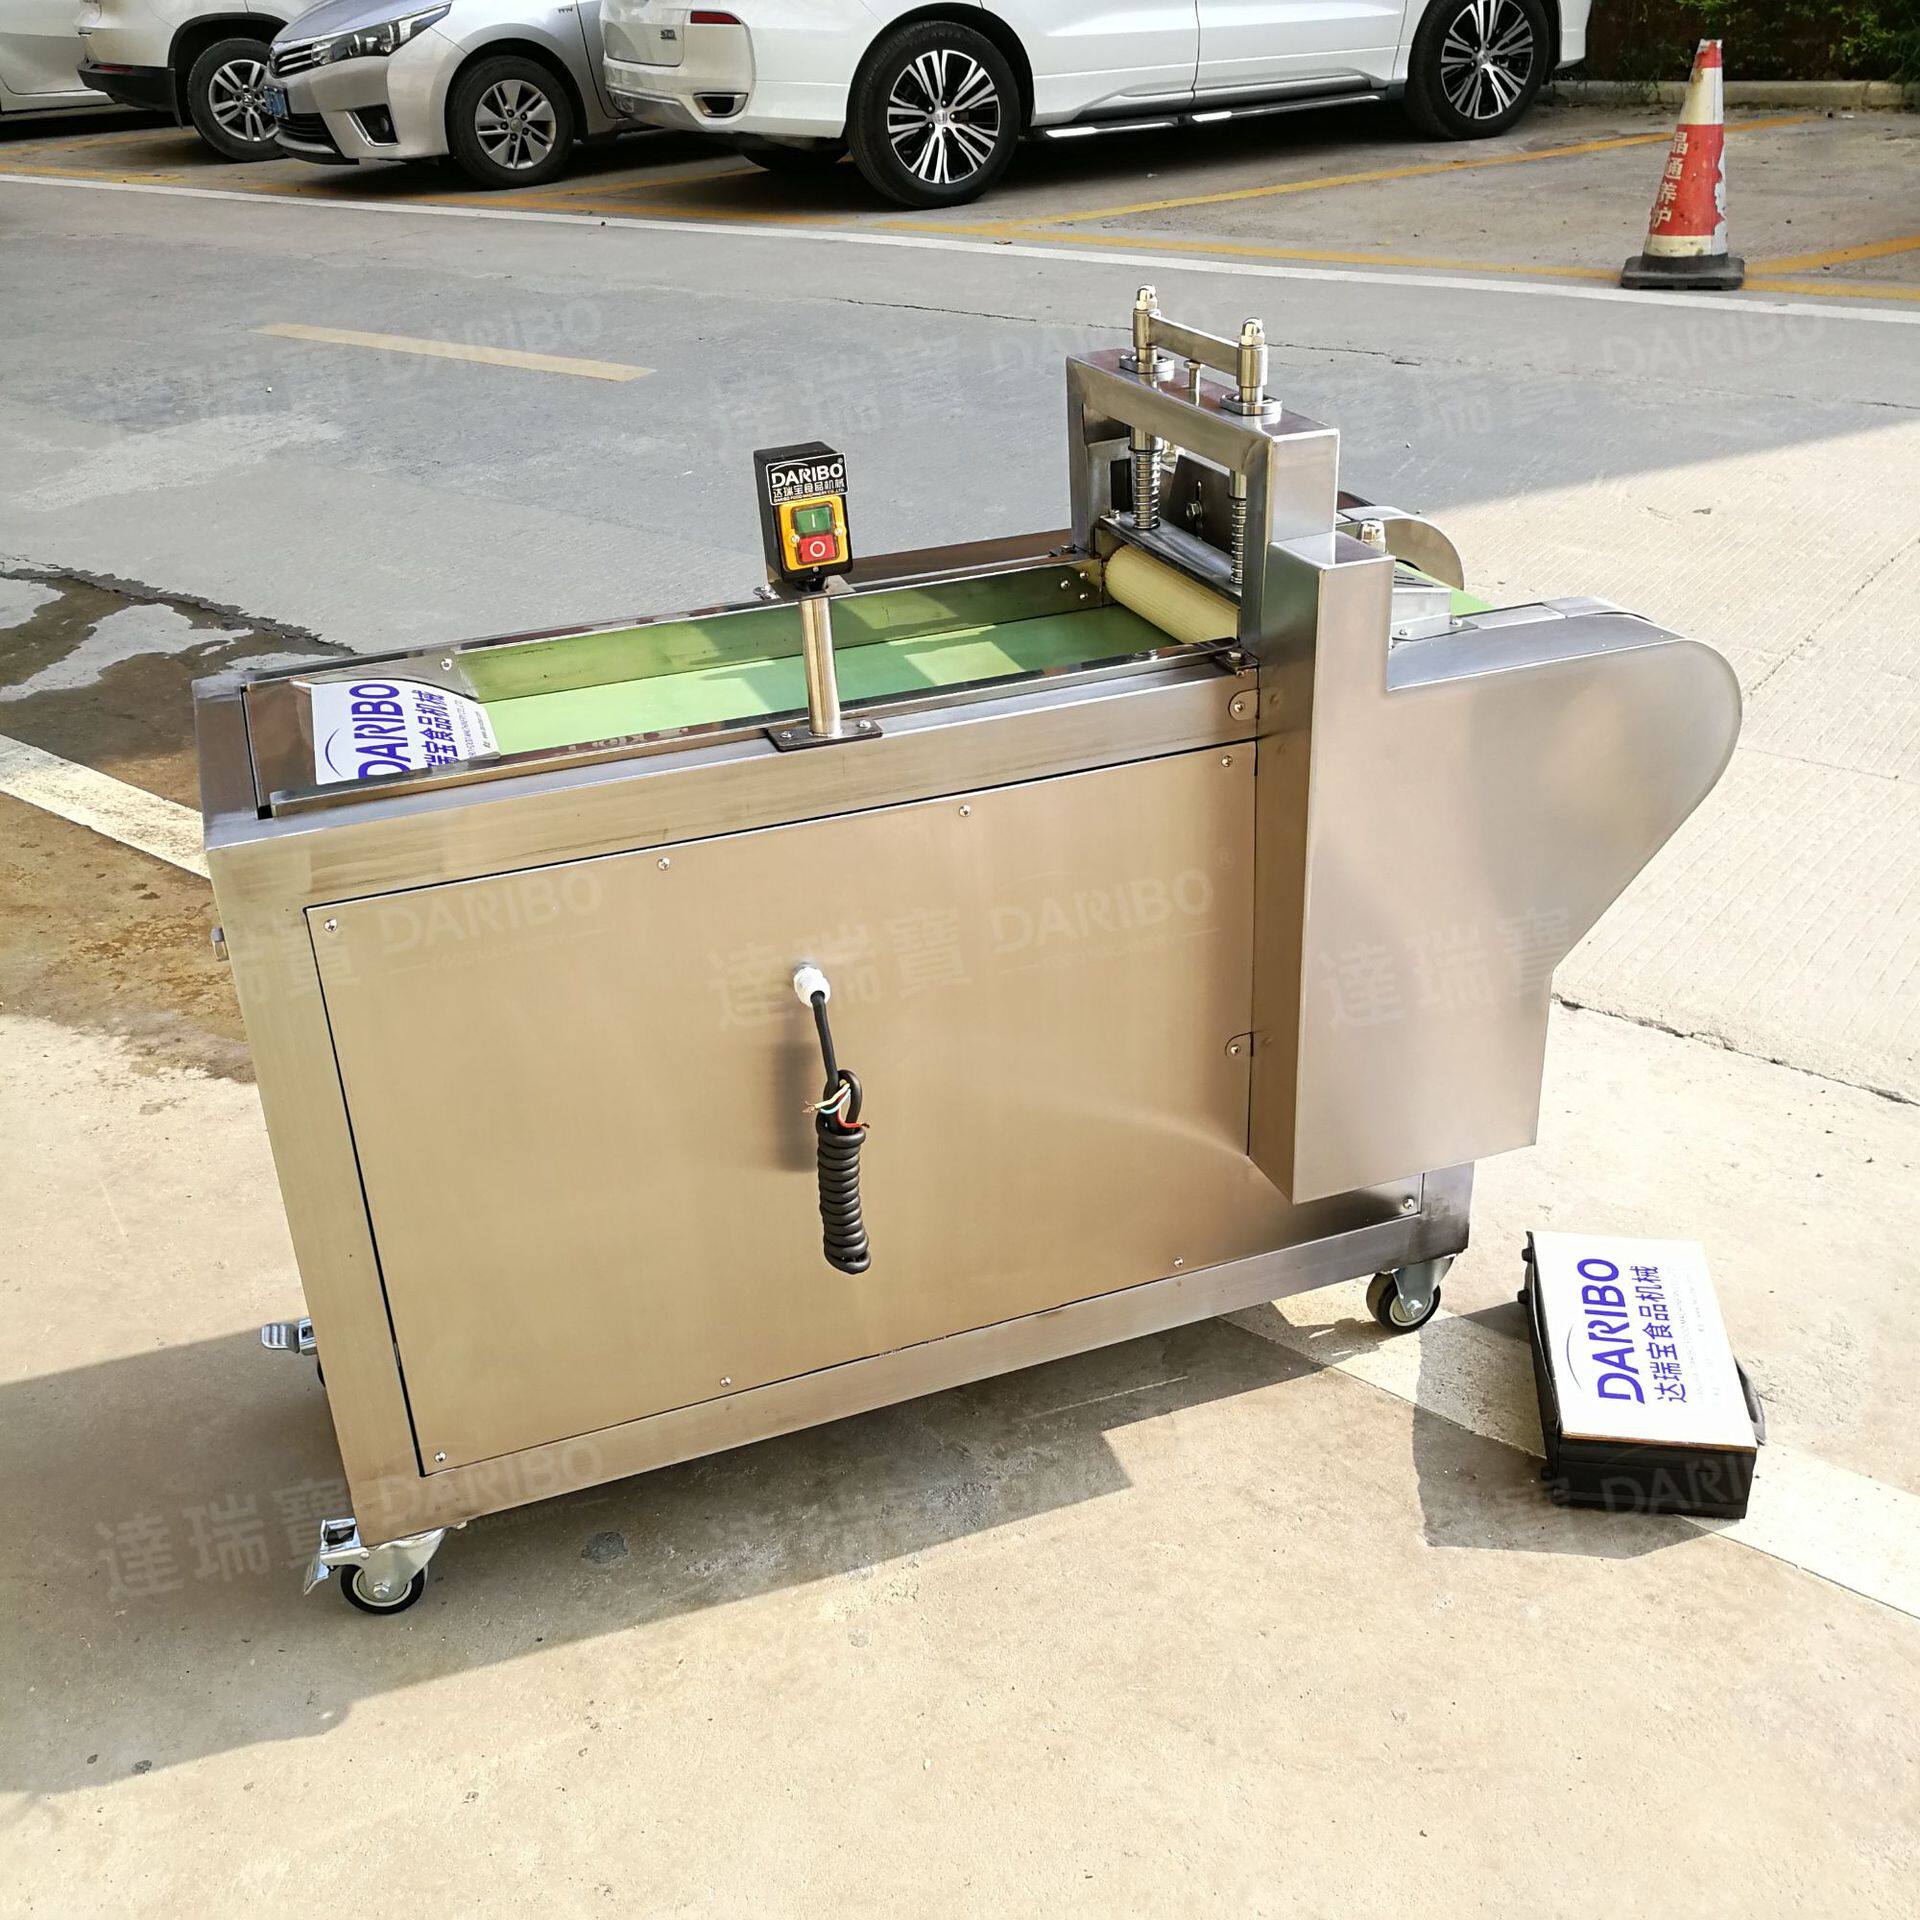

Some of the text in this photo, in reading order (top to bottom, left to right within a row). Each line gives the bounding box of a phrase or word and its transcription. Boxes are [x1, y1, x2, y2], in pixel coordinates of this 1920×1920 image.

[771, 463, 843, 488] DARIBO
[349, 683, 411, 779] DARIBO
[1577, 1258, 1645, 1404] DARIBO
[1629, 1266, 1688, 1402] 达瑞宝食品机械
